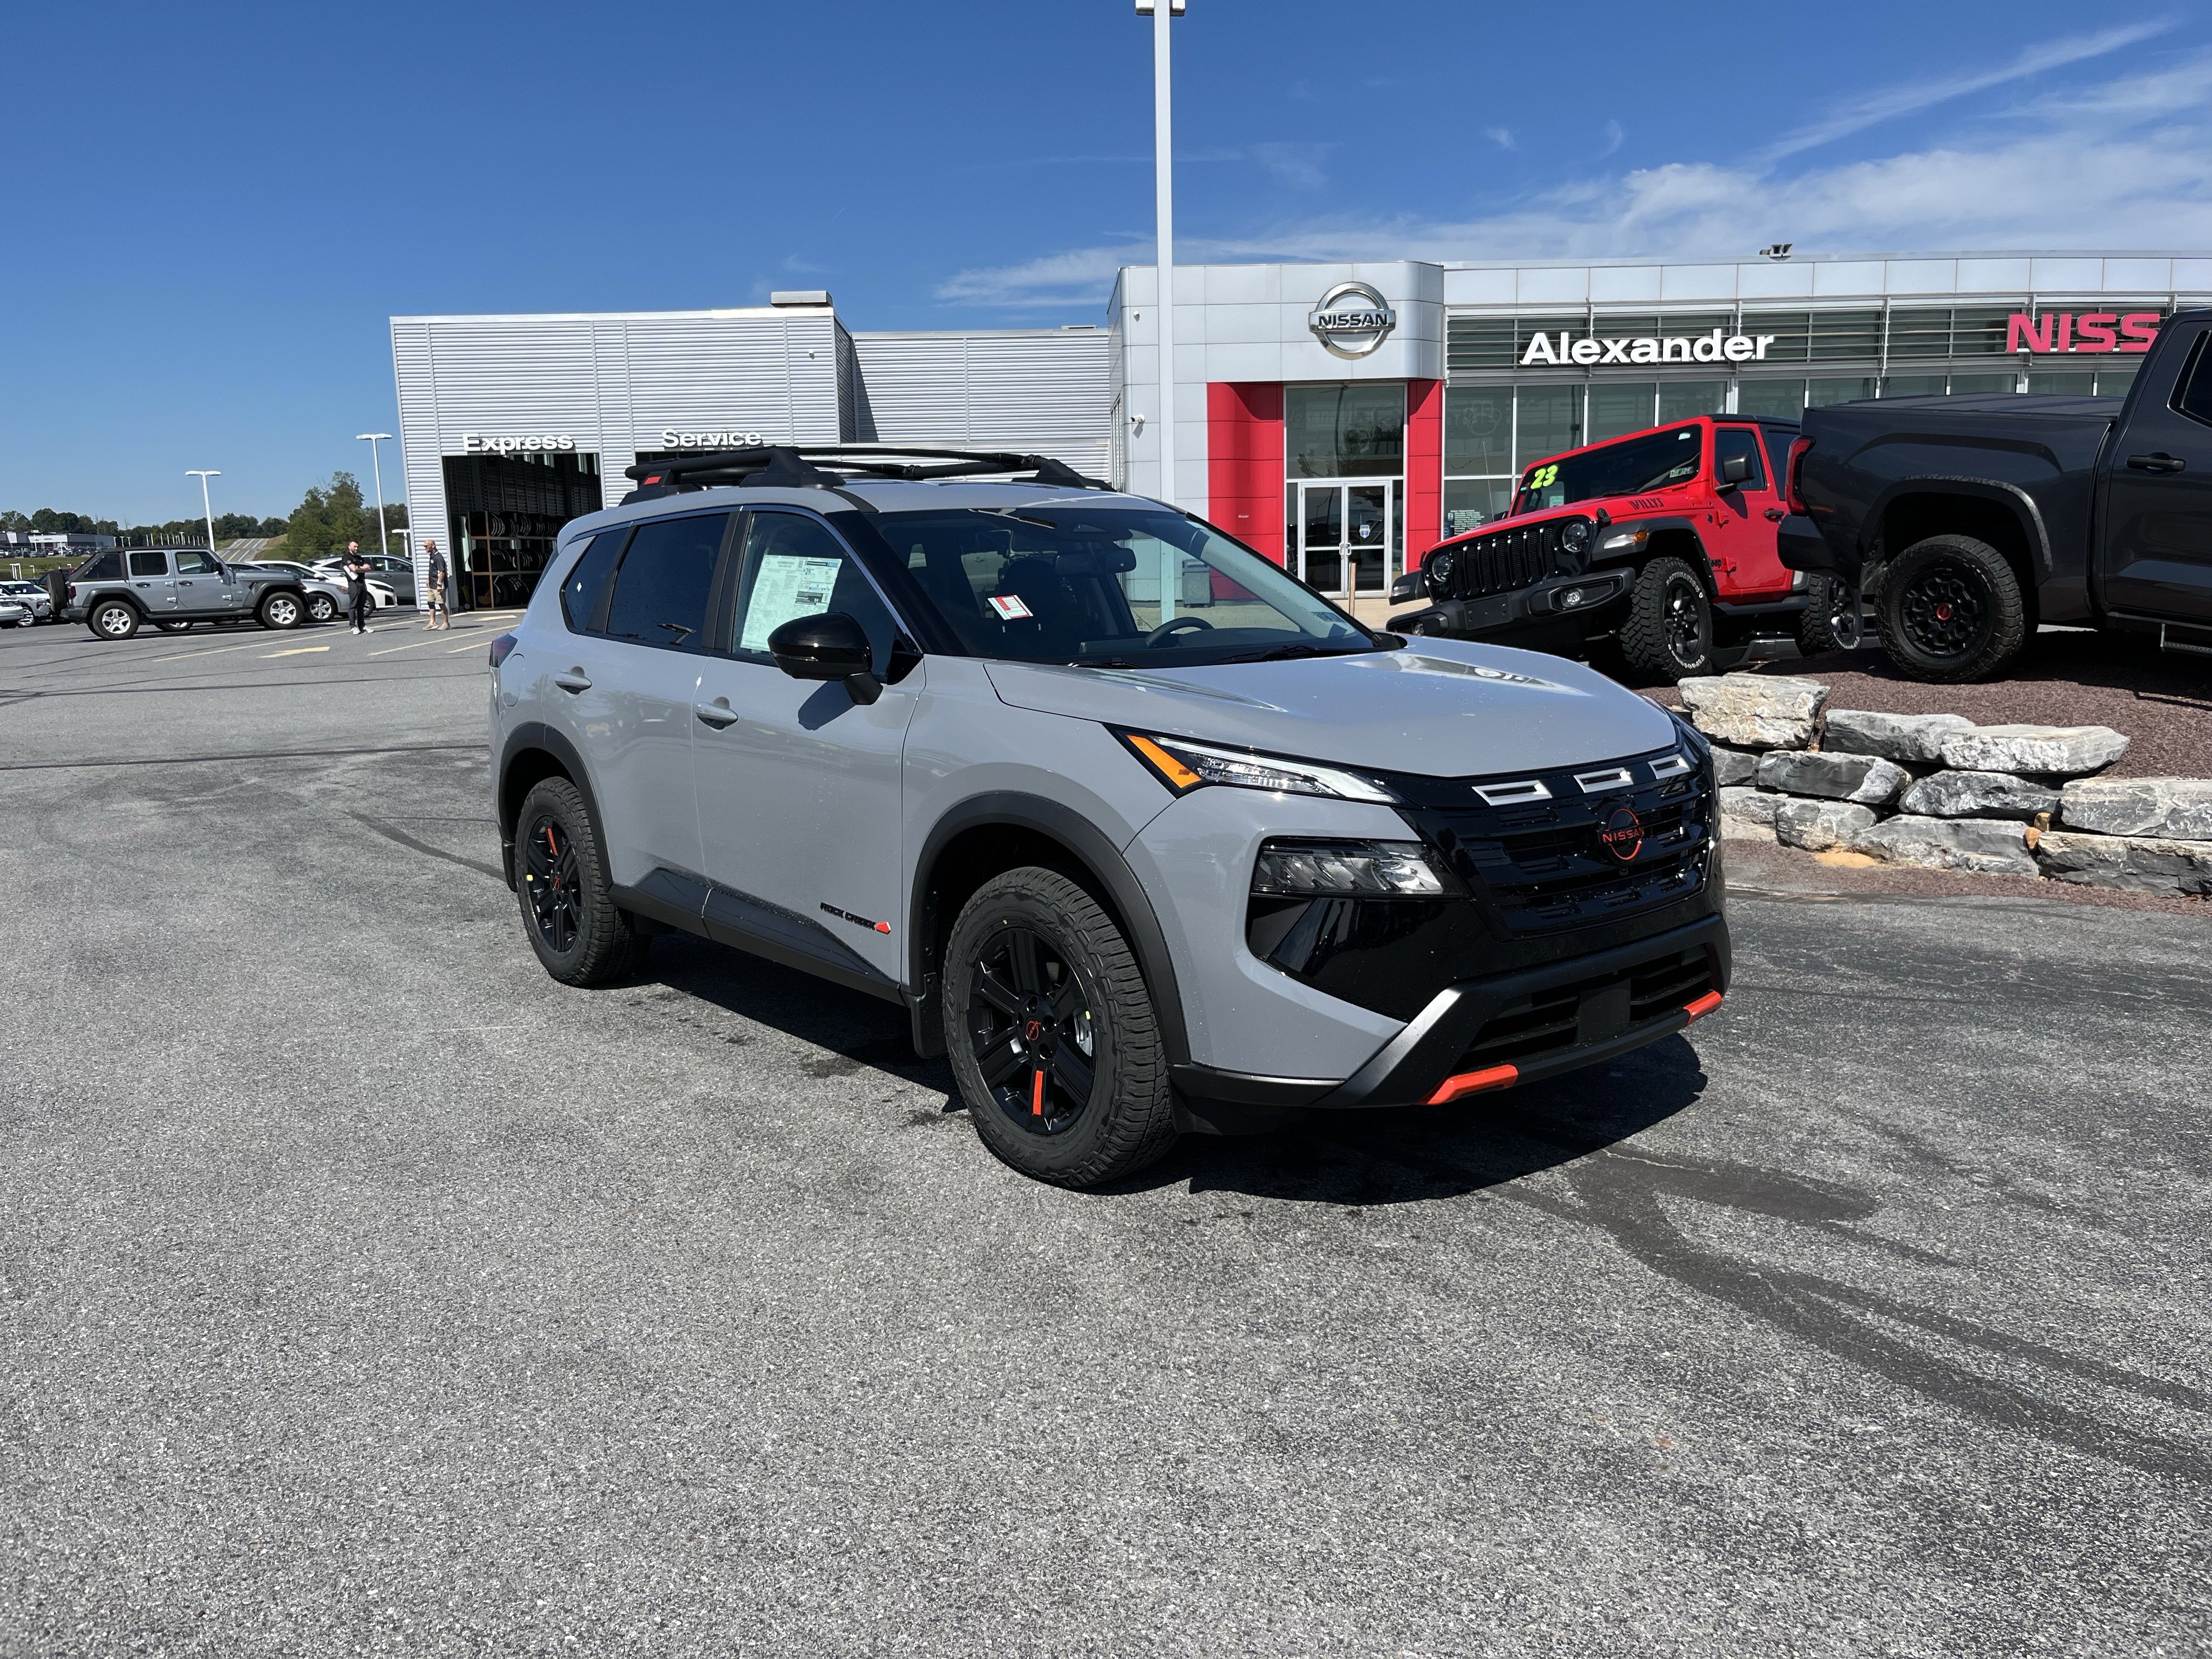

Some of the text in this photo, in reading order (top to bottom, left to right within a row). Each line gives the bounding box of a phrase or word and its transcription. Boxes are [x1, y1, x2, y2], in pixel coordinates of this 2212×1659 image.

[1318, 313, 1388, 329] NISSAN
[1520, 328, 1775, 365] Alexander
[462, 428, 763, 455] Express Service
[1530, 465, 1558, 489] 23
[1627, 497, 1664, 510] WILLYS
[1602, 826, 1645, 843] NISSAN
